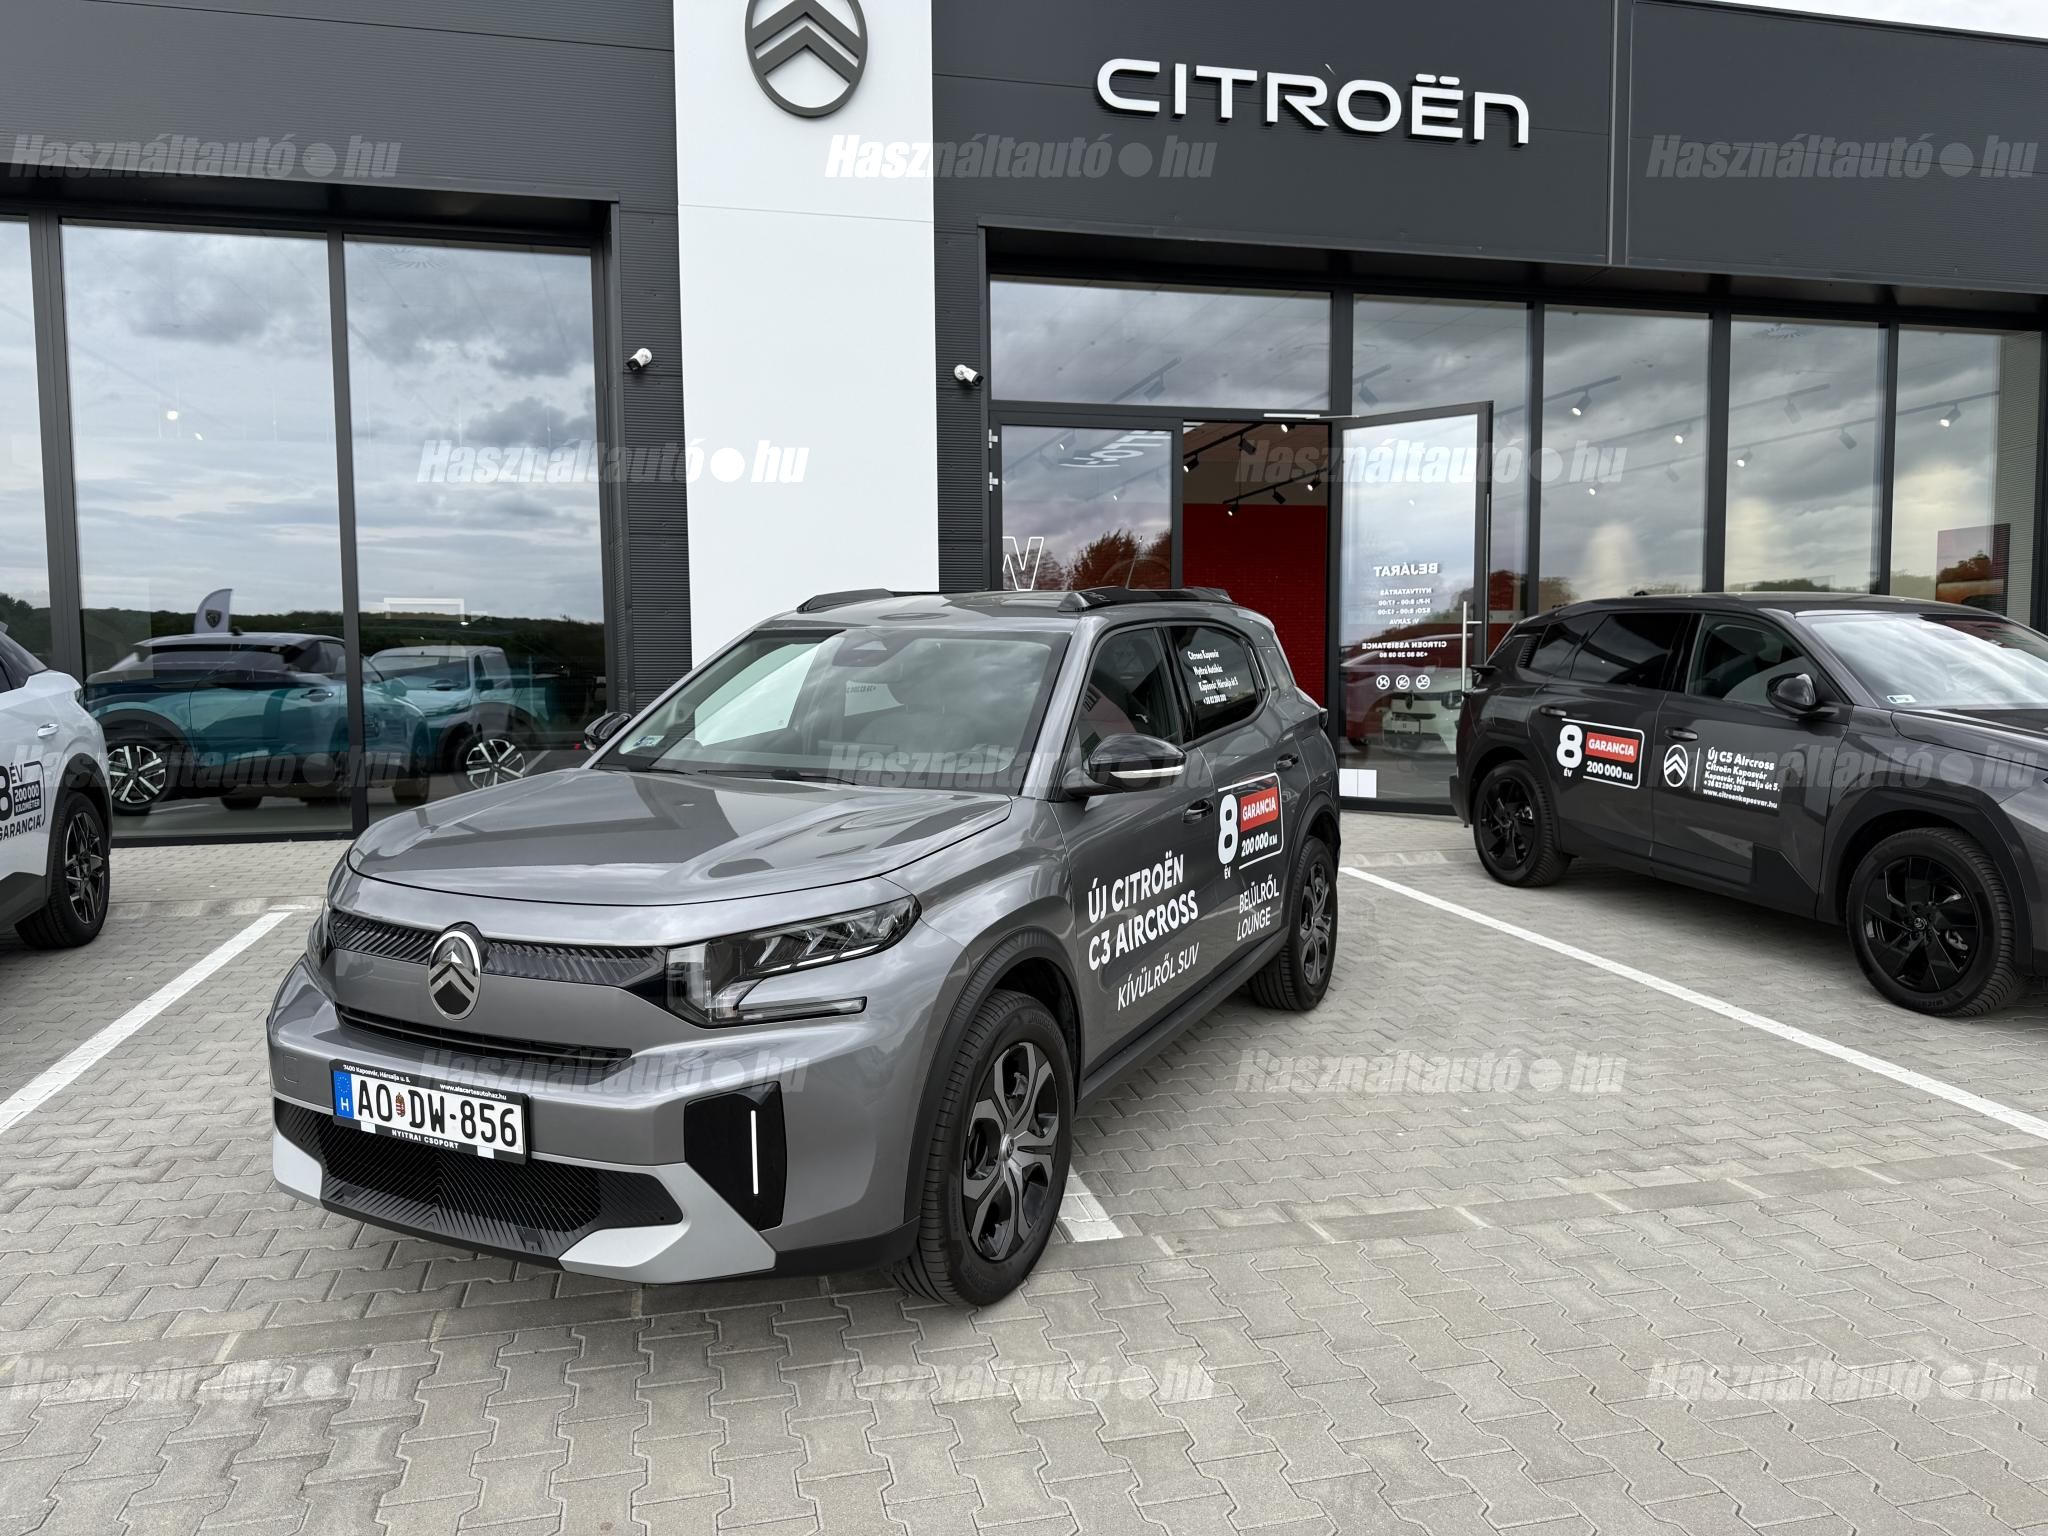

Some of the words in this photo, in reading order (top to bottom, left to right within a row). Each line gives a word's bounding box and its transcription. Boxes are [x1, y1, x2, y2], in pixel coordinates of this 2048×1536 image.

[1096, 58, 1530, 146] CITROËN
[1556, 724, 1583, 769] 8
[1588, 739, 1635, 757] GARANCIA
[1719, 751, 1733, 764] C5
[1734, 753, 1775, 771] Aircross
[9, 762, 23, 784] ÉV
[1564, 767, 1573, 778] ÉV
[1706, 761, 1732, 774] Citroën
[1733, 766, 1767, 780] Kaposvár
[1242, 796, 1277, 821] GARANCIA
[1217, 793, 1239, 865] 8
[1088, 877, 1107, 924] ÚJ
[1111, 850, 1184, 912] CITROËN
[1223, 865, 1231, 880] ÉV
[1239, 874, 1280, 914] BELÜLRŐL
[1088, 929, 1111, 971] C3
[1115, 889, 1199, 958] AIRCROSS
[1236, 906, 1271, 941] LOUNGE
[1117, 952, 1175, 1011] KÍVÜLRŐL
[1177, 941, 1200, 974] SUV
[340, 1098, 349, 1112] H
[408, 1089, 517, 1147] DW-856
[392, 1129, 421, 1142] NYITRAI
[424, 1136, 459, 1150] CSOPORT
